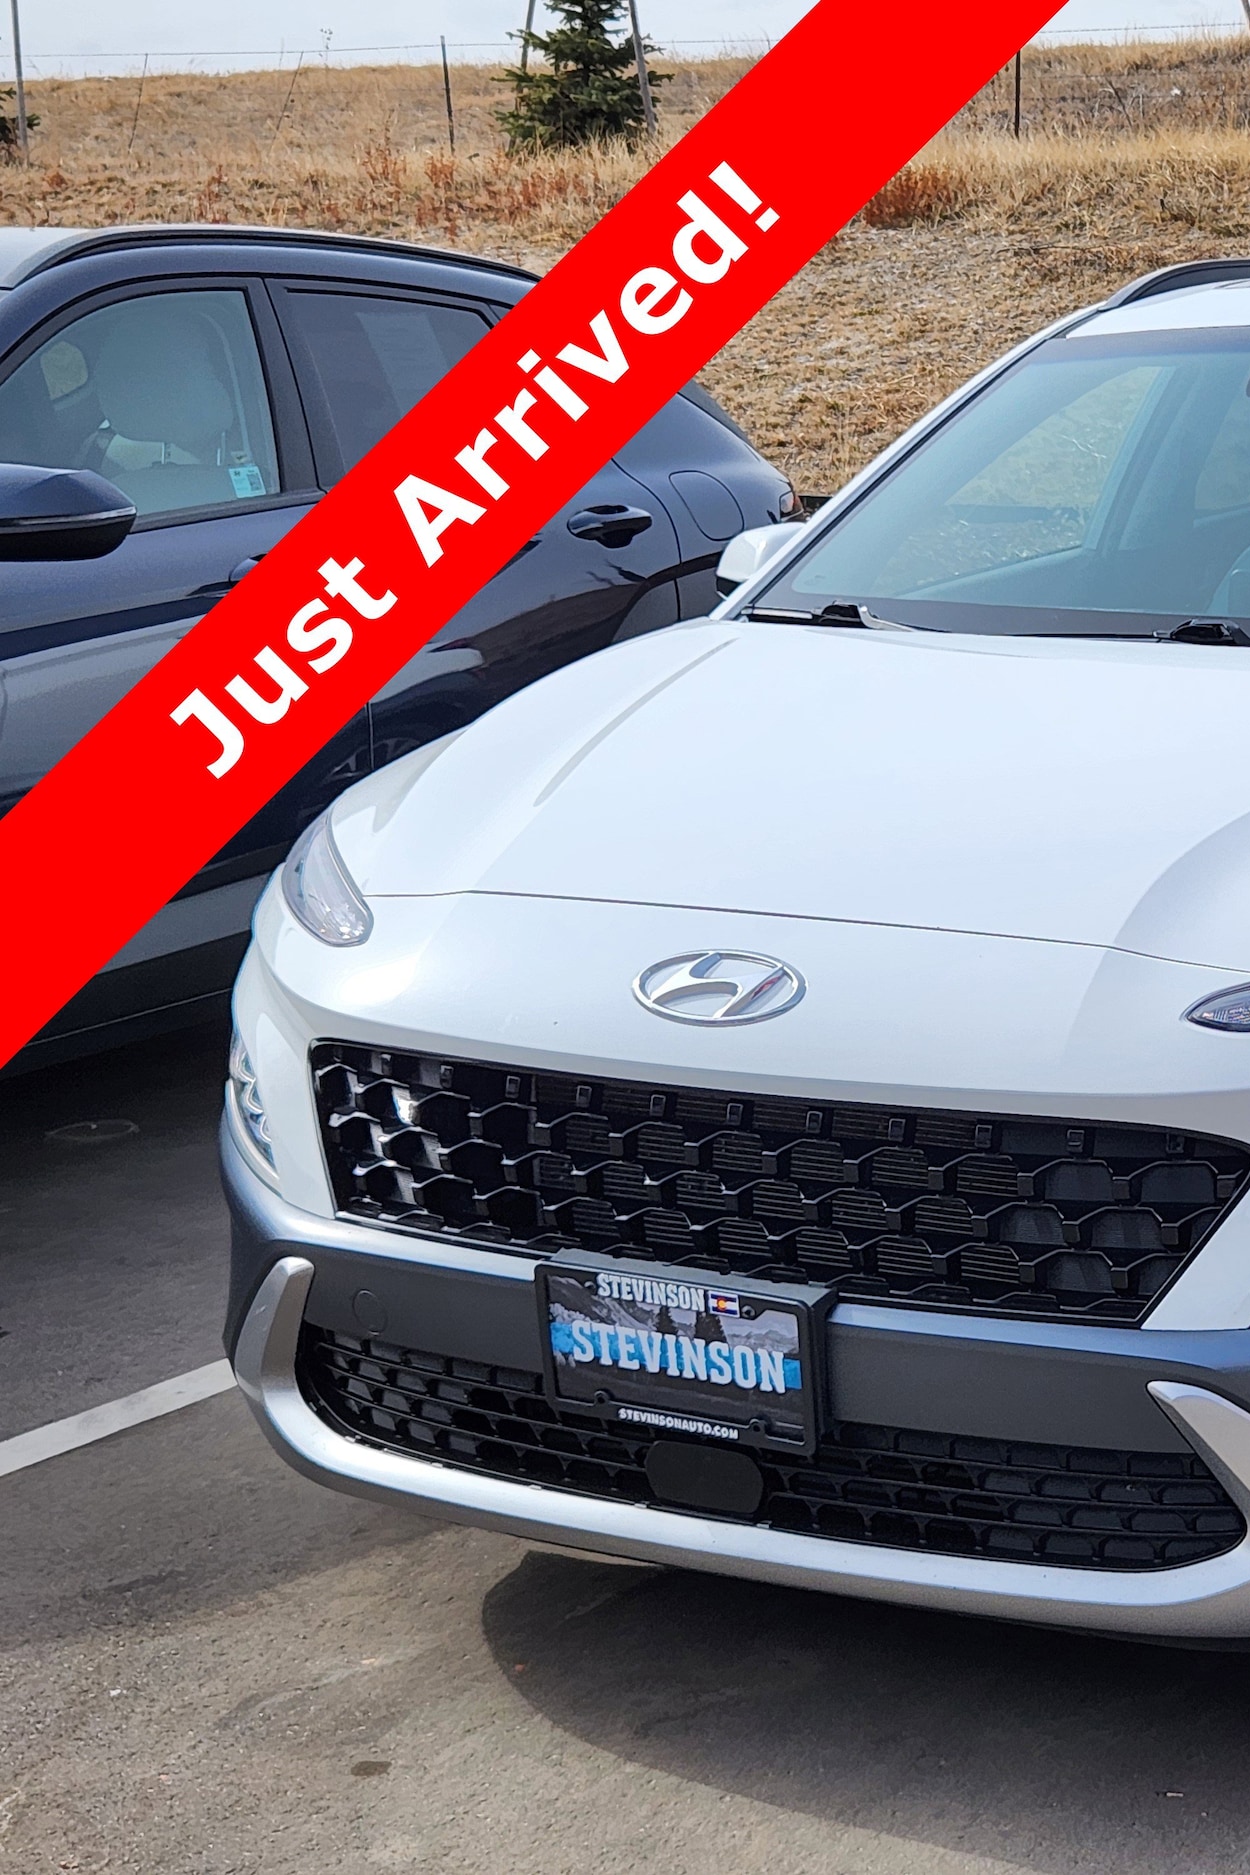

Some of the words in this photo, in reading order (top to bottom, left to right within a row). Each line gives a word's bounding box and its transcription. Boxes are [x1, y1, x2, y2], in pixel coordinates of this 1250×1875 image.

[597, 1273, 705, 1312] STEVINSON
[572, 1320, 786, 1394] STEVINSON
[618, 1408, 739, 1440] STEVINSONAUTO.COM
